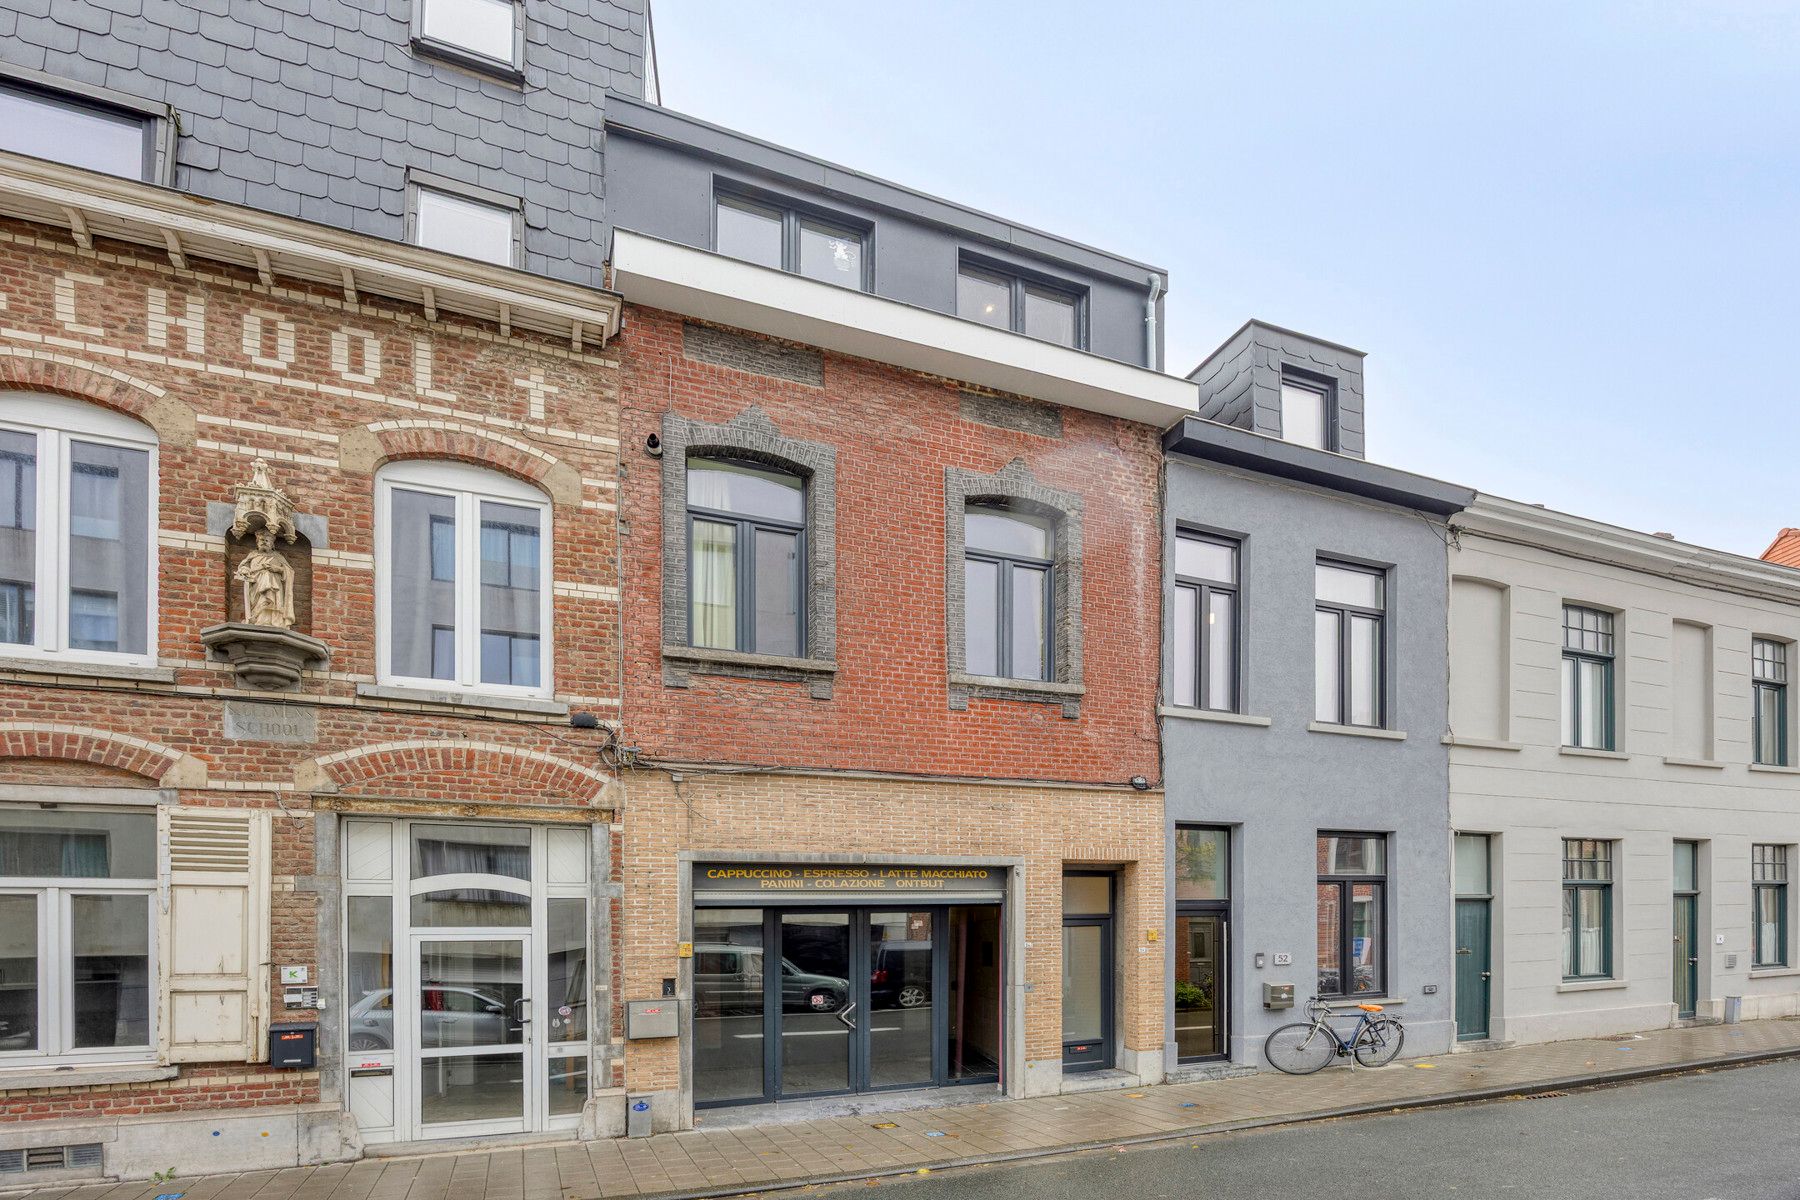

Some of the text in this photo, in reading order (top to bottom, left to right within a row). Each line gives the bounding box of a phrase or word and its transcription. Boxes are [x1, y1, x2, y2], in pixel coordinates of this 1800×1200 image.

[0, 271, 456, 400] CHOOL
[235, 720, 304, 738] SCHOOL
[707, 869, 792, 879] CAPPUCCINO
[803, 869, 869, 879] ESPRESSO
[880, 869, 918, 878] LATTE
[921, 870, 988, 879] MACCHIATO
[760, 879, 803, 888] PANINI
[815, 879, 885, 888] COLAZIONE
[896, 879, 945, 888] ONTBIJT
[1278, 954, 1288, 962] 52
